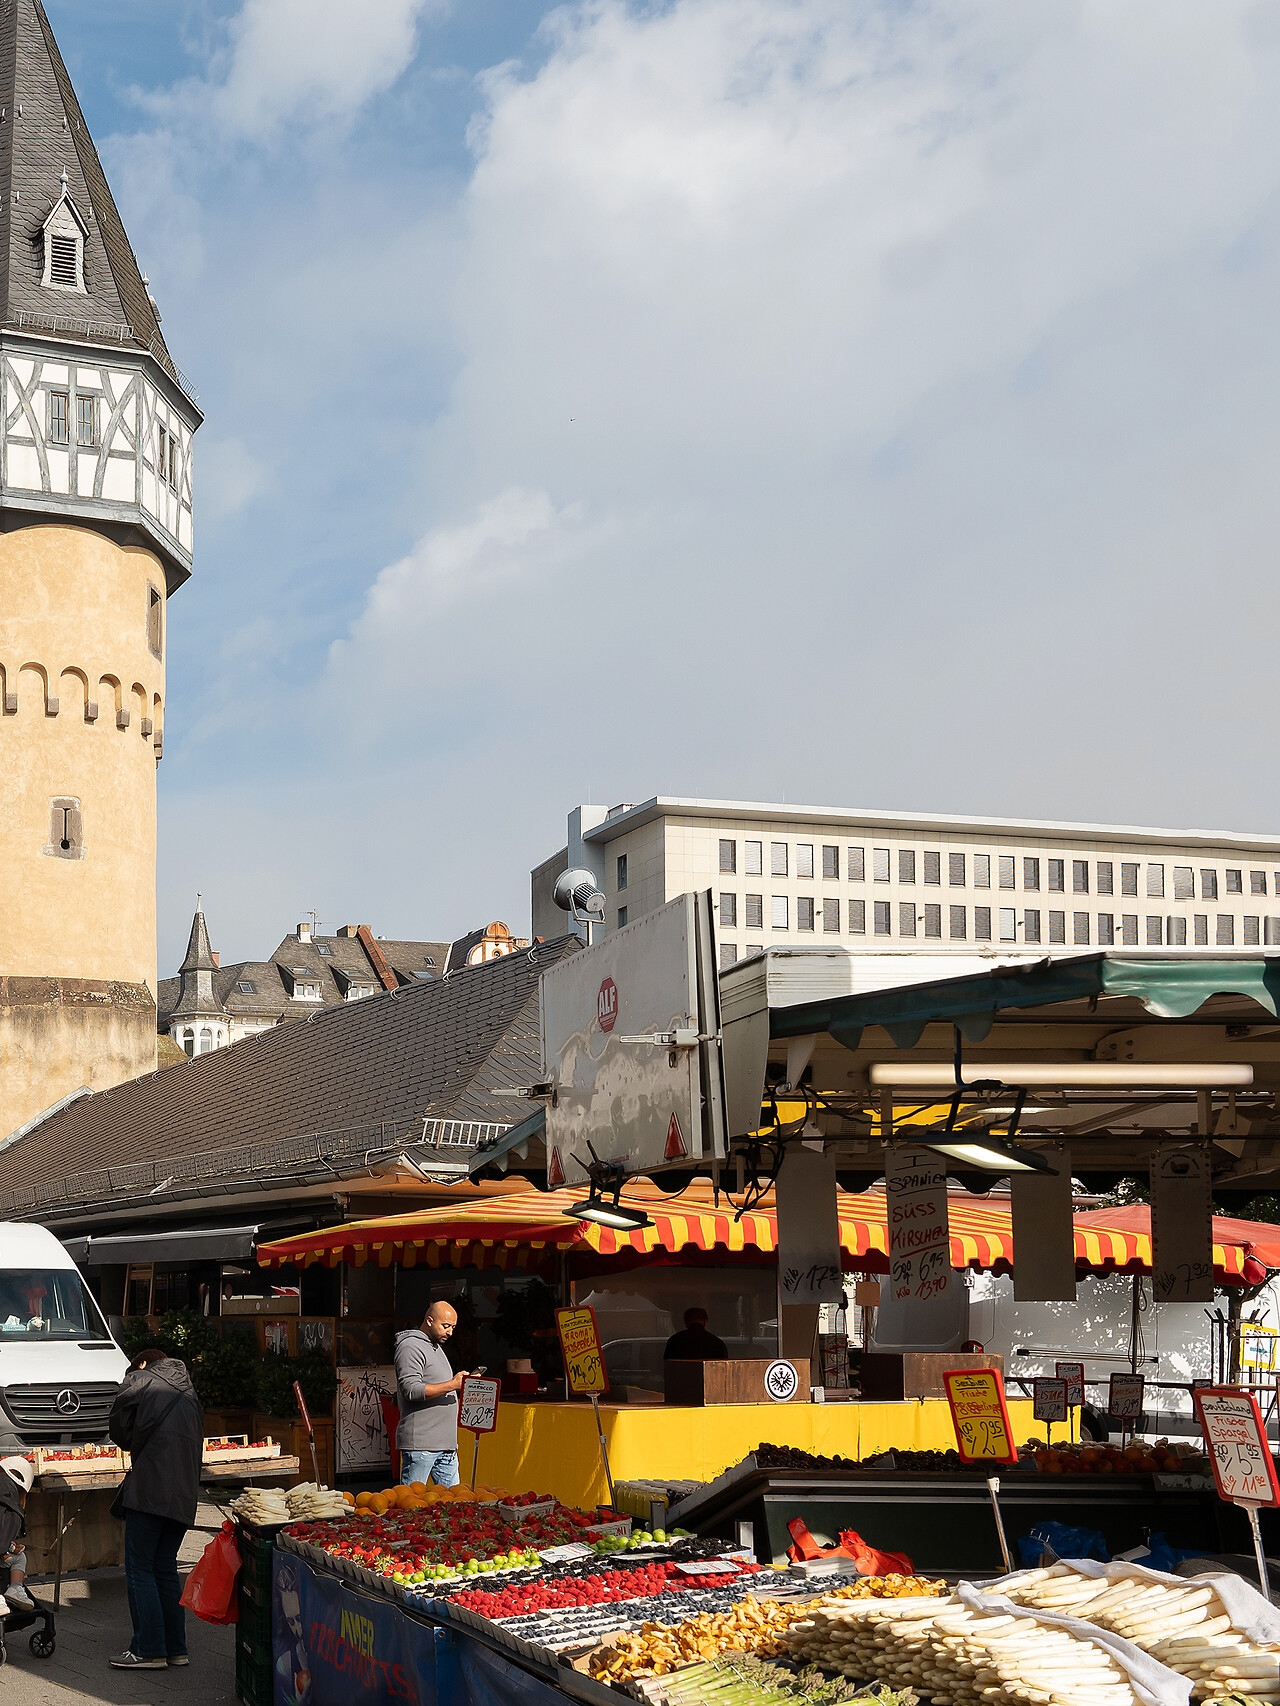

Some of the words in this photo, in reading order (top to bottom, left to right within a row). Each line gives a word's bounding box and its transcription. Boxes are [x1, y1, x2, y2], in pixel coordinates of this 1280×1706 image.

[599, 985, 616, 1017] ALF
[888, 1171, 946, 1192] SPANIEN
[892, 1202, 936, 1223] SÜSS
[891, 1225, 949, 1251] KIRSCHEN
[1211, 1425, 1254, 1442] Spargel
